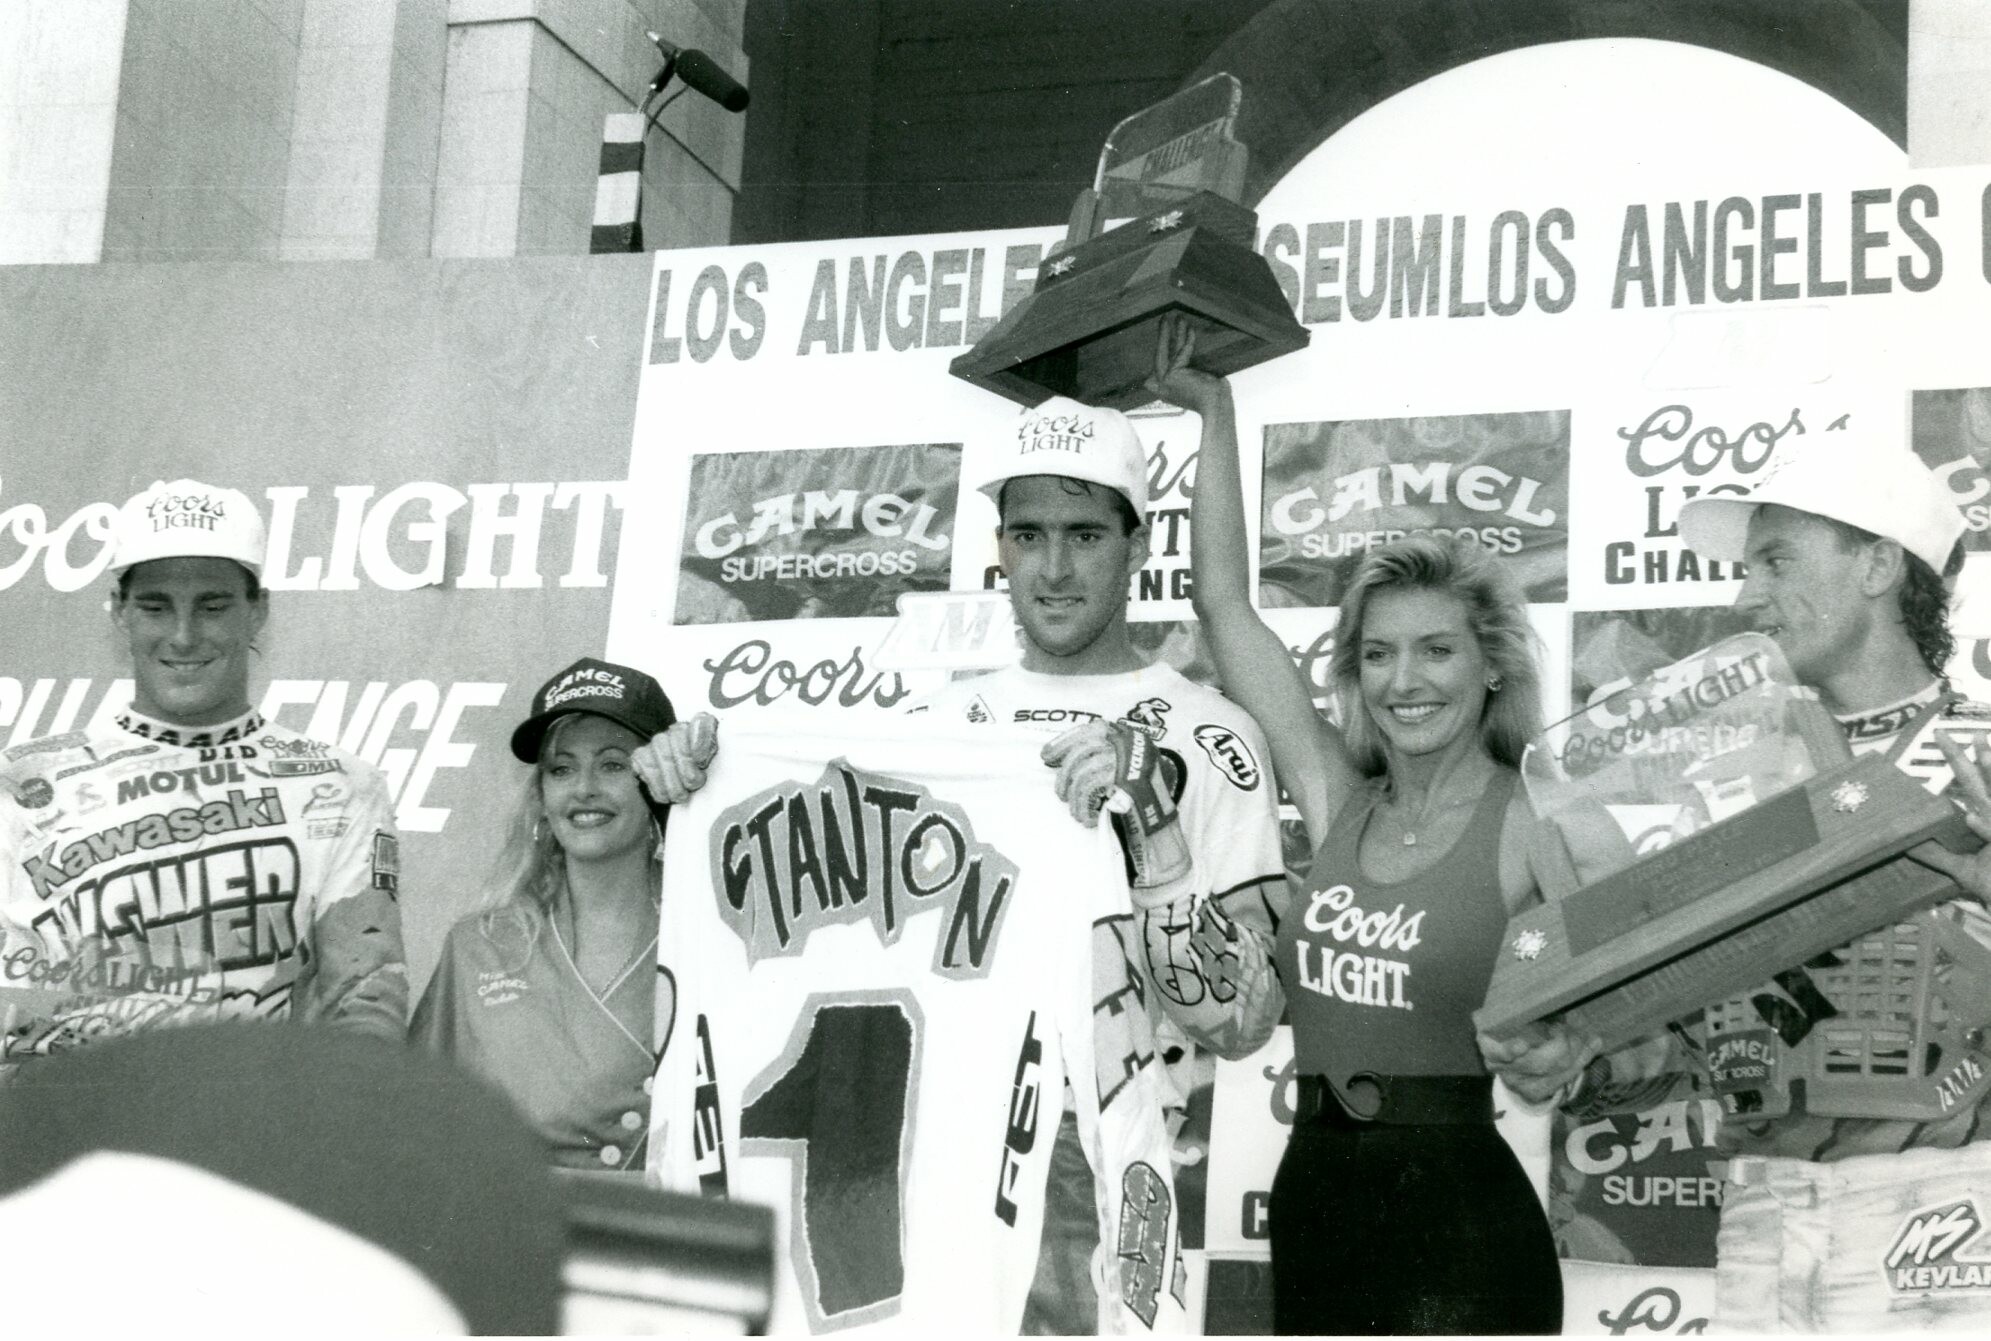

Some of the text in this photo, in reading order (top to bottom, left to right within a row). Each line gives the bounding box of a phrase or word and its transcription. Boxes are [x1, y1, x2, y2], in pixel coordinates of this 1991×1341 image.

[648, 261, 769, 365] LOS
[796, 240, 1064, 358] ANGELE
[1611, 183, 1943, 310] ANGELES
[1020, 434, 1085, 455] LIGHT
[153, 512, 218, 533] LIGHT
[695, 489, 950, 560] CAMEL
[1271, 462, 1557, 535] CAMEL
[263, 482, 629, 591] LIGHT
[721, 550, 918, 583] SUPERCROSS
[545, 668, 625, 700] CAMEL
[703, 639, 912, 710] Coors
[1661, 651, 1767, 722] LIGHT
[1013, 709, 1102, 725] SCOTT
[117, 762, 246, 804] MOTUL
[1204, 732, 1258, 782] Arai
[22, 786, 287, 900] Kawasaki
[722, 767, 1011, 969] STANTON
[1304, 884, 1427, 951] Coors
[1708, 1039, 1775, 1072] CAMEL
[740, 1004, 914, 1317] 1
[1602, 1175, 1723, 1207] SUPER
